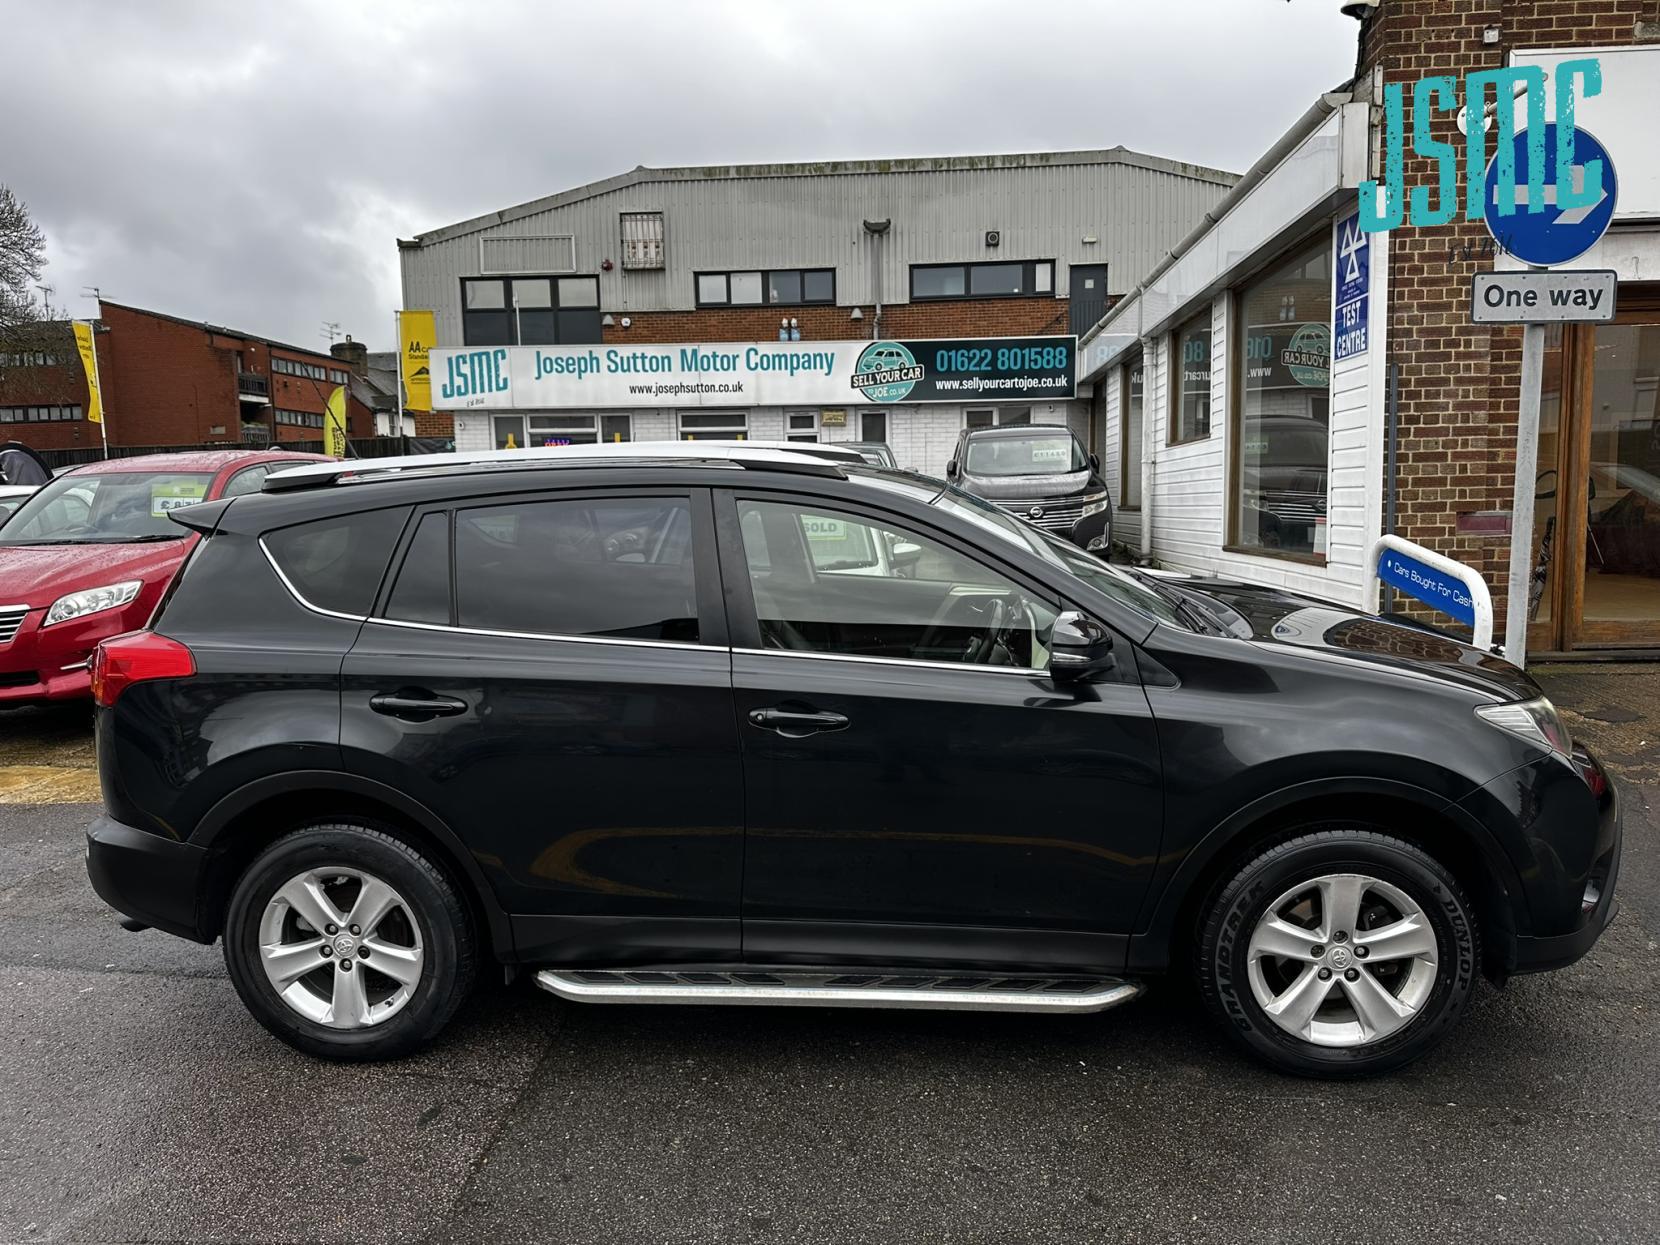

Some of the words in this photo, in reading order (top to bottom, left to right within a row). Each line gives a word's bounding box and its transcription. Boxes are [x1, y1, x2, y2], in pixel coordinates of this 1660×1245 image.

[1483, 284, 1538, 308] One
[1549, 287, 1604, 310] way
[1342, 300, 1361, 328] TEST
[1337, 328, 1366, 357] CENTRE
[535, 350, 600, 380] Joseph
[606, 349, 672, 373] Sutton
[680, 348, 739, 371] Motor
[746, 347, 835, 376] Company
[936, 348, 992, 371] 01622
[997, 346, 1067, 370] 801588
[442, 349, 508, 398] JSMC
[853, 375, 874, 387] SELL
[875, 370, 900, 384] YOUR
[901, 367, 921, 380] CAR
[935, 375, 1068, 392] www.sellyourcartojoe.co.uk
[629, 381, 743, 396] www.josephsutton.co.uk
[803, 522, 837, 533] SOLD
[1394, 562, 1410, 578] Cars
[1411, 570, 1436, 590] Bought
[1438, 583, 1452, 597] For
[1453, 590, 1474, 609] Cash
[1446, 901, 1472, 992] DUNLOP
